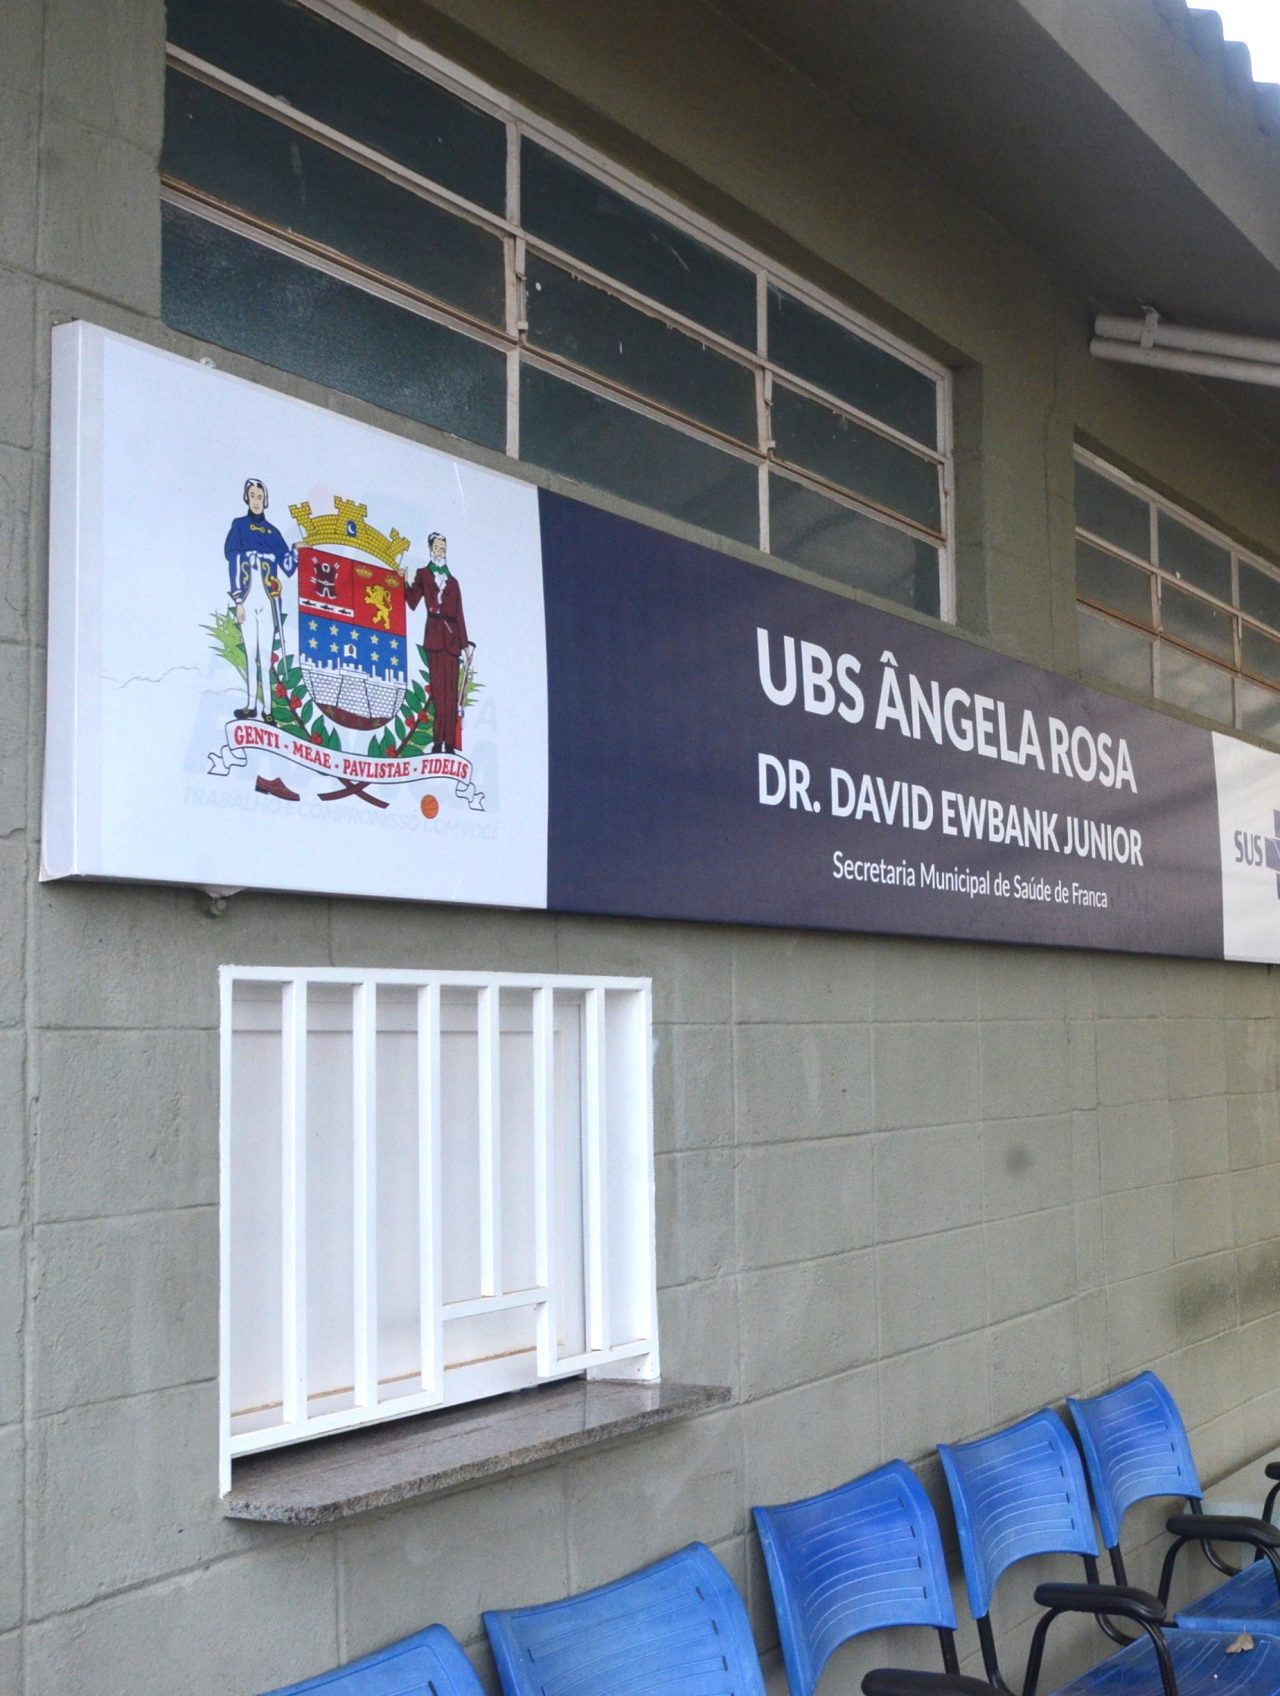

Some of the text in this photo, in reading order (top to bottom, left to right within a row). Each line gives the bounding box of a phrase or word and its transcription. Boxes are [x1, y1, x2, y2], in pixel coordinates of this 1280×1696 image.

[757, 627, 1138, 794] UBS ÂNGELA ROSA
[234, 725, 469, 779] GENTI MEAE PAVLISTAE FIDELIS
[758, 753, 1144, 866] DR. DAVID EWBANK JUNIOR
[1234, 830, 1263, 867] SUS
[832, 850, 1108, 908] Secretaria Municipal de Saúde de Franca
